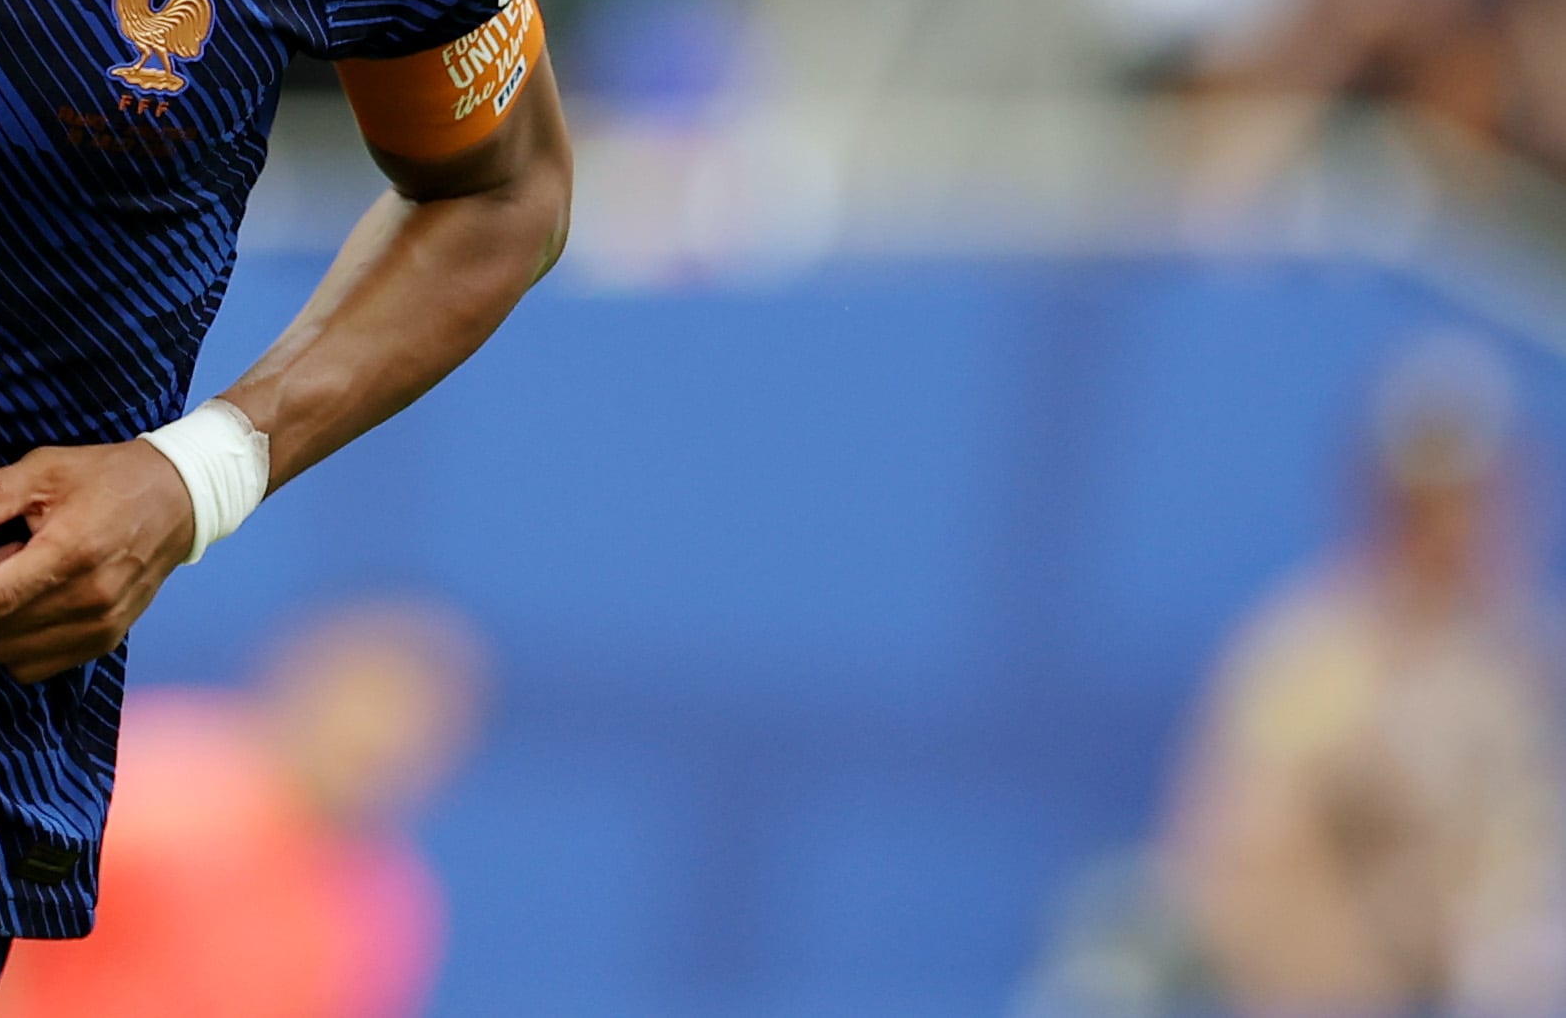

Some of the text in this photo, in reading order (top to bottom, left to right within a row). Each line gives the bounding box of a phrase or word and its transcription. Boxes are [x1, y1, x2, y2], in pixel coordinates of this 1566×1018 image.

[118, 94, 170, 117] FFF
[451, 81, 495, 120] the
[497, 66, 523, 108] FIFA
